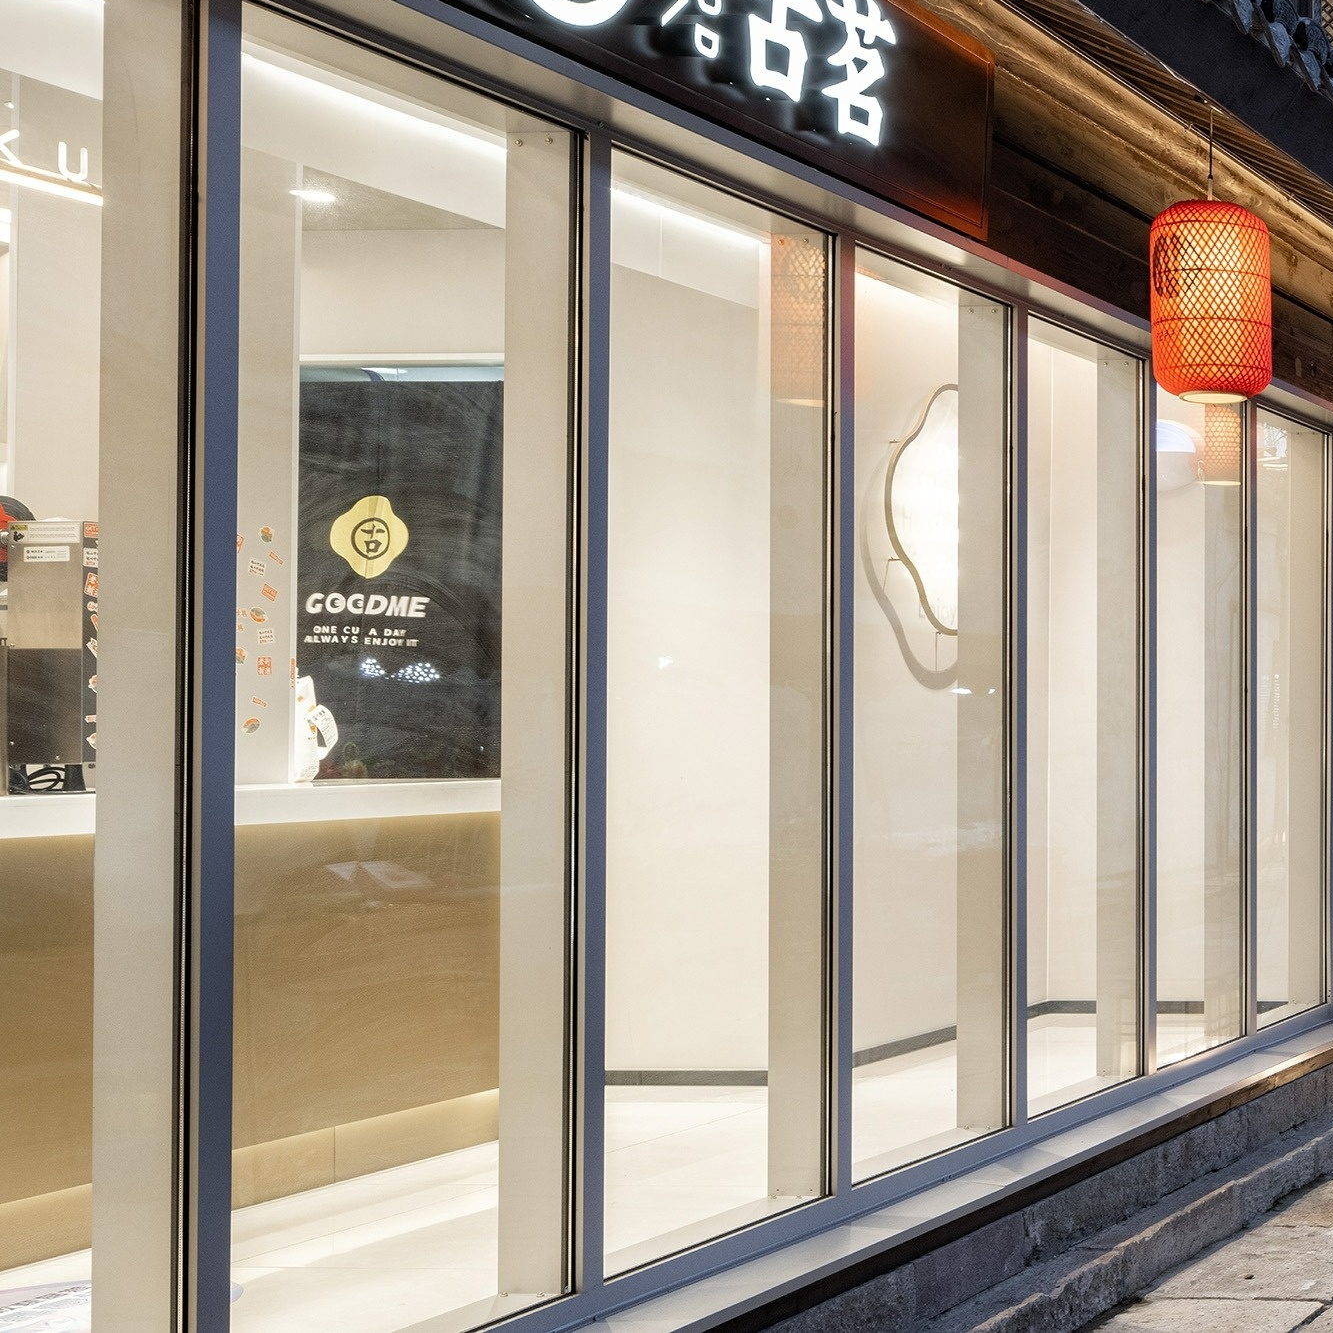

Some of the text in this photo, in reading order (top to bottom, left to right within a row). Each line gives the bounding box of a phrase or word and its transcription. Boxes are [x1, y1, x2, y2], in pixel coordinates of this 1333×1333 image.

[313, 625, 338, 634] ONE
[343, 626, 360, 635] CU
[368, 627, 378, 636] A
